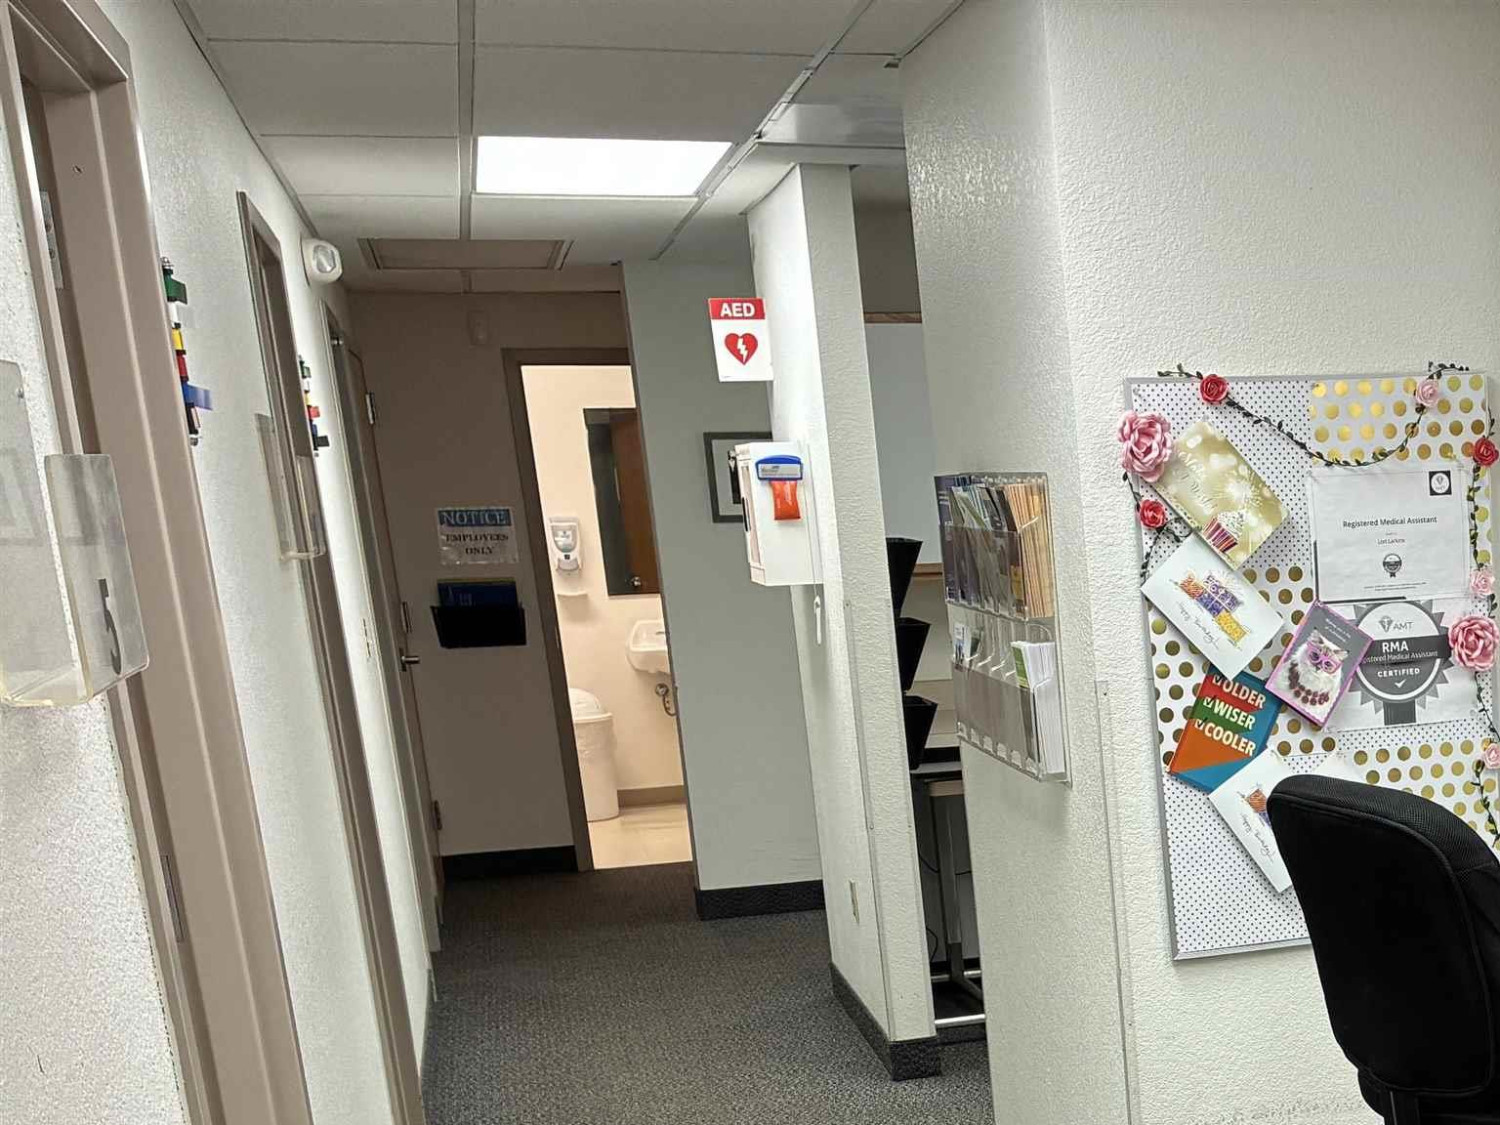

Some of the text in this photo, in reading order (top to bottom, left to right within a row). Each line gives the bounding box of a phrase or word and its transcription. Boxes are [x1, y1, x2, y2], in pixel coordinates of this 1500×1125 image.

[720, 302, 755, 318] AED
[443, 511, 506, 525] NOTICE
[1342, 515, 1438, 530] Registered Medical Assistant
[446, 533, 509, 543] EMPLOYEES
[464, 547, 494, 555] ONLY
[97, 578, 122, 675] 5
[1392, 621, 1414, 632] AMT
[1382, 640, 1409, 653] RMA
[1387, 652, 1411, 661] Medical
[1410, 651, 1439, 659] Assistant
[1377, 668, 1420, 678] CERTIFIED
[1221, 680, 1267, 710] OLDER
[1213, 698, 1256, 730] WISER
[1204, 722, 1257, 757] COOLER
